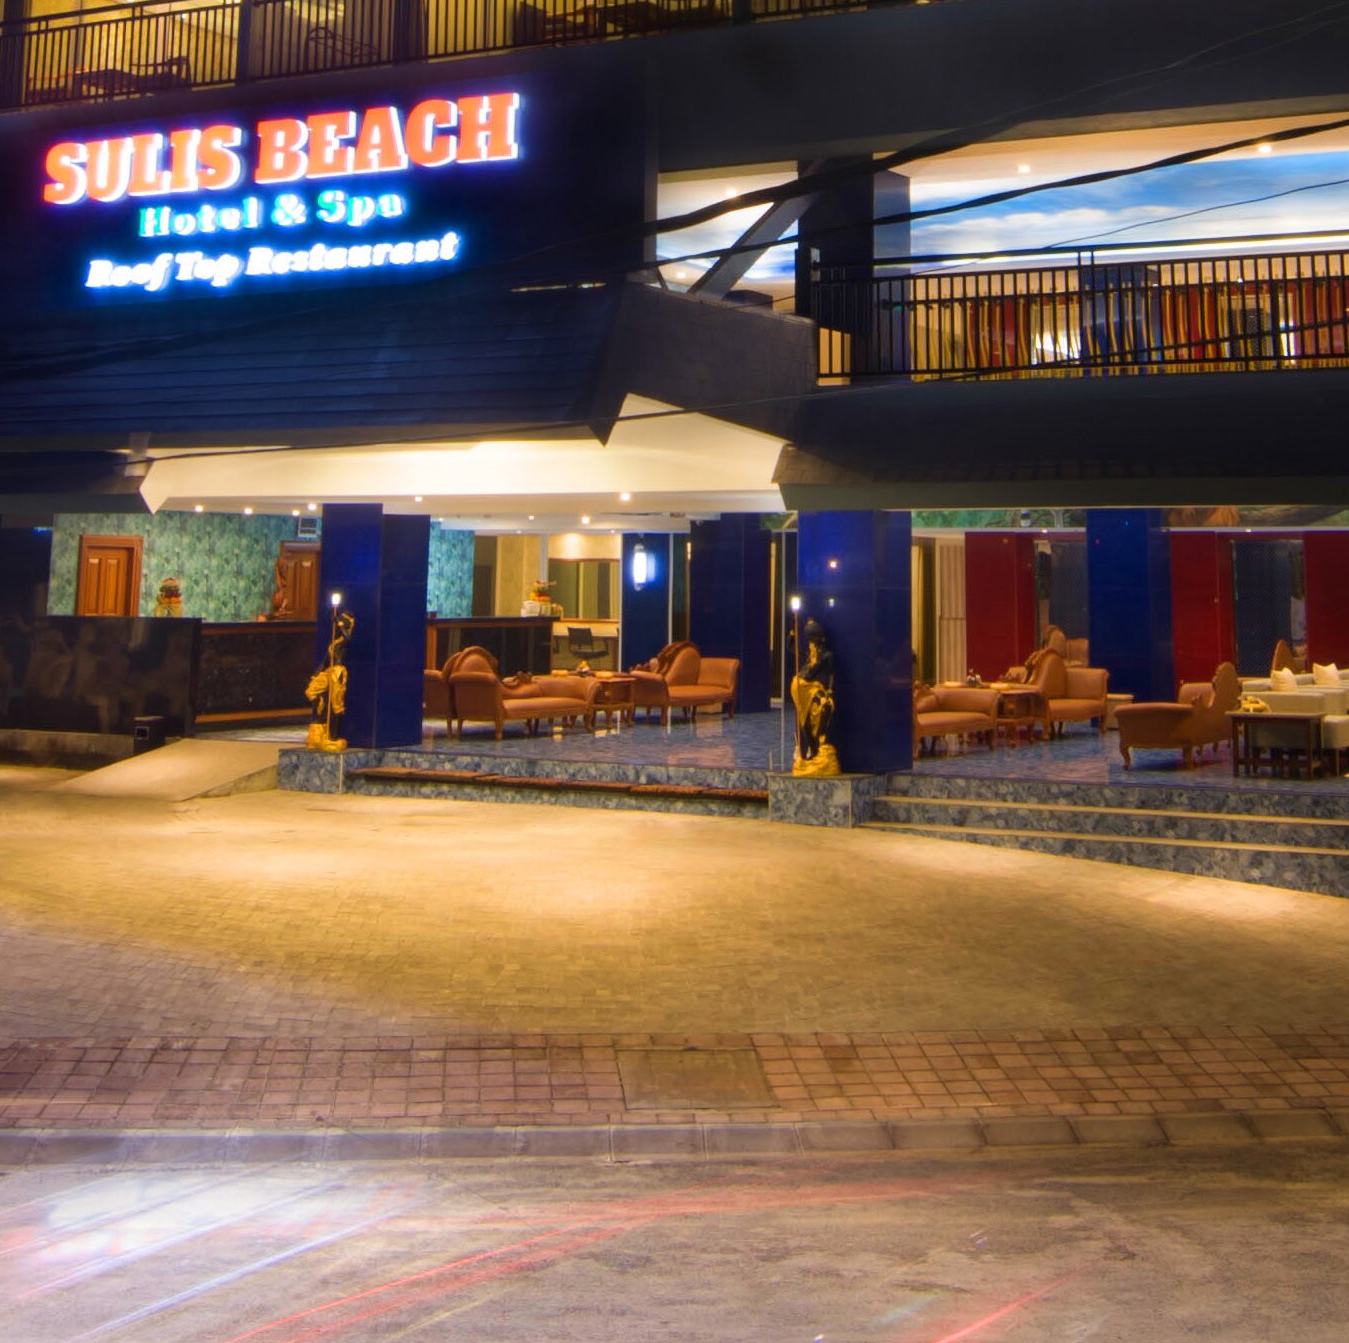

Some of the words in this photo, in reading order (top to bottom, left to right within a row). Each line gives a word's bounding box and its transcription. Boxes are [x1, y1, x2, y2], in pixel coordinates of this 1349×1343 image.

[43, 125, 241, 204] SULIS
[254, 93, 519, 184] BEACH
[139, 197, 259, 237] Hotel
[271, 194, 307, 226] &
[316, 191, 404, 226] Spa
[86, 254, 173, 291] Roof
[176, 252, 241, 287] Top
[245, 233, 460, 275] Restaurant
